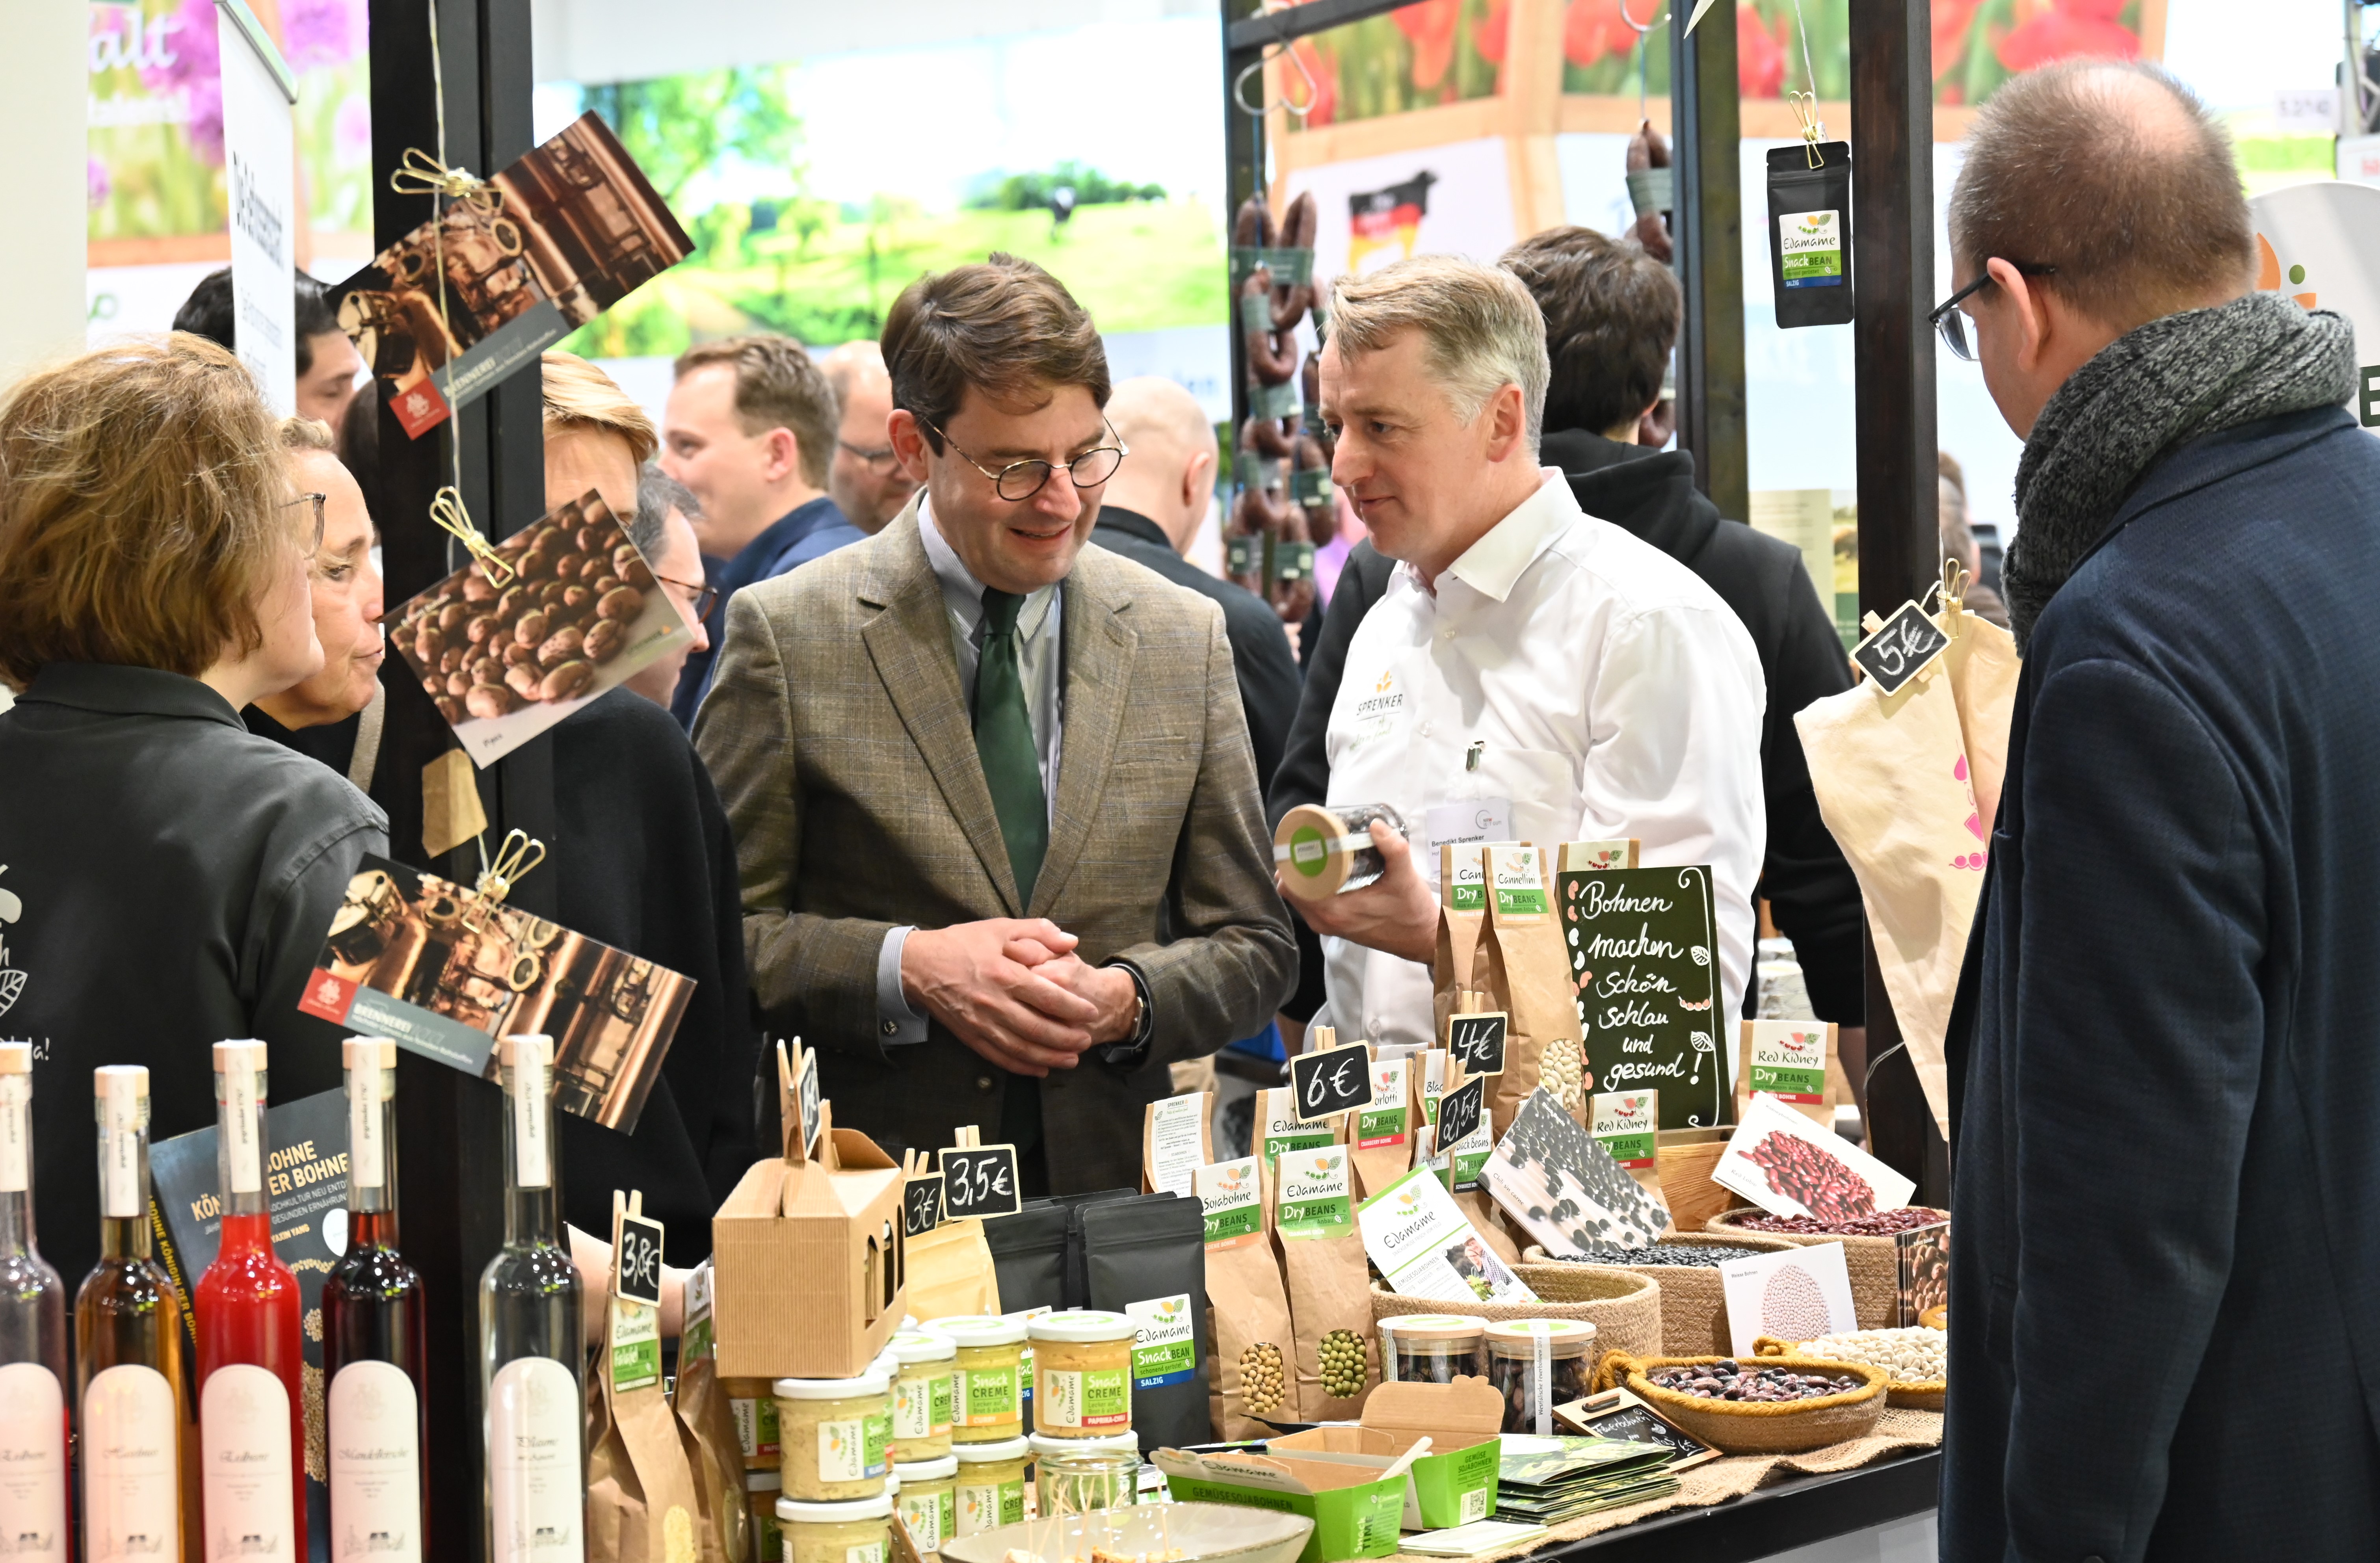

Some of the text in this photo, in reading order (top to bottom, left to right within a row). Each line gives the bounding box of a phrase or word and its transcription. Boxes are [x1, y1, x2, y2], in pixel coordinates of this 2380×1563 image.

[1783, 236, 1836, 250] Edamame
[1872, 618, 1939, 676] 5€
[1357, 694, 1403, 716] SPRENKER
[1432, 835, 1484, 847] Benedikt Sprenker
[1498, 873, 1535, 885] Cannellini
[1579, 881, 1673, 920] Bohnen
[1588, 922, 1684, 959] machen
[1458, 1022, 1498, 1067] 4€
[1623, 1033, 1653, 1055] und
[1758, 1051, 1818, 1068] Red Kidney
[1307, 1057, 1361, 1108] 6€
[1375, 1091, 1397, 1106] orlotti
[1542, 1102, 1553, 1114] Black
[1443, 1087, 1479, 1142] 2,5€
[1273, 1120, 1328, 1132] Edamame
[1597, 1119, 1647, 1132] Red Kidney
[1471, 1137, 1489, 1150] Beans
[268, 1173, 291, 1196] ER
[952, 1157, 1013, 1206] 3,5€
[1287, 1182, 1343, 1197] Edamame
[1493, 1173, 1504, 1184] Chili
[1511, 1191, 1524, 1206] carne
[313, 1187, 326, 1202] NEU
[1204, 1191, 1251, 1210] Sojabohne
[271, 1207, 309, 1225] GESUNDEN
[907, 1187, 936, 1234] 3€
[1284, 1204, 1336, 1223] DryBEANS
[292, 1223, 311, 1237] YANG
[1384, 1211, 1436, 1248] Edamame
[1393, 1239, 1415, 1257] SNACKGEMÜSE
[1415, 1231, 1426, 1243] FRISCH
[159, 1240, 183, 1287] KÖNIGIN
[1396, 1256, 1439, 1288] GEMÜSESOJABOHNEN
[1135, 1324, 1190, 1342] Edamame
[1137, 1346, 1190, 1366] SnackBEAN
[1140, 1362, 1182, 1375] schonend geröstet
[973, 1372, 1008, 1388] Snack
[1088, 1373, 1121, 1388] Snack
[1140, 1376, 1164, 1387] SALZIG
[973, 1386, 1008, 1398] CREME
[1066, 1375, 1075, 1424] Edamame
[1088, 1387, 1121, 1398] CREME
[915, 1385, 923, 1434] Edamame
[1592, 1415, 1651, 1434] Feuerbohnen
[848, 1425, 858, 1476] Edamame
[1465, 1451, 1486, 1463] GEMÜSE
[1458, 1457, 1492, 1473] SOJABOHNEN
[1004, 1497, 1023, 1510] CREM
[1192, 1487, 1293, 1511] GEMÜSESOJABOHNEN
[985, 1489, 993, 1531] damame
[1354, 1517, 1366, 1554] Snack
[1362, 1514, 1374, 1552] TIME
